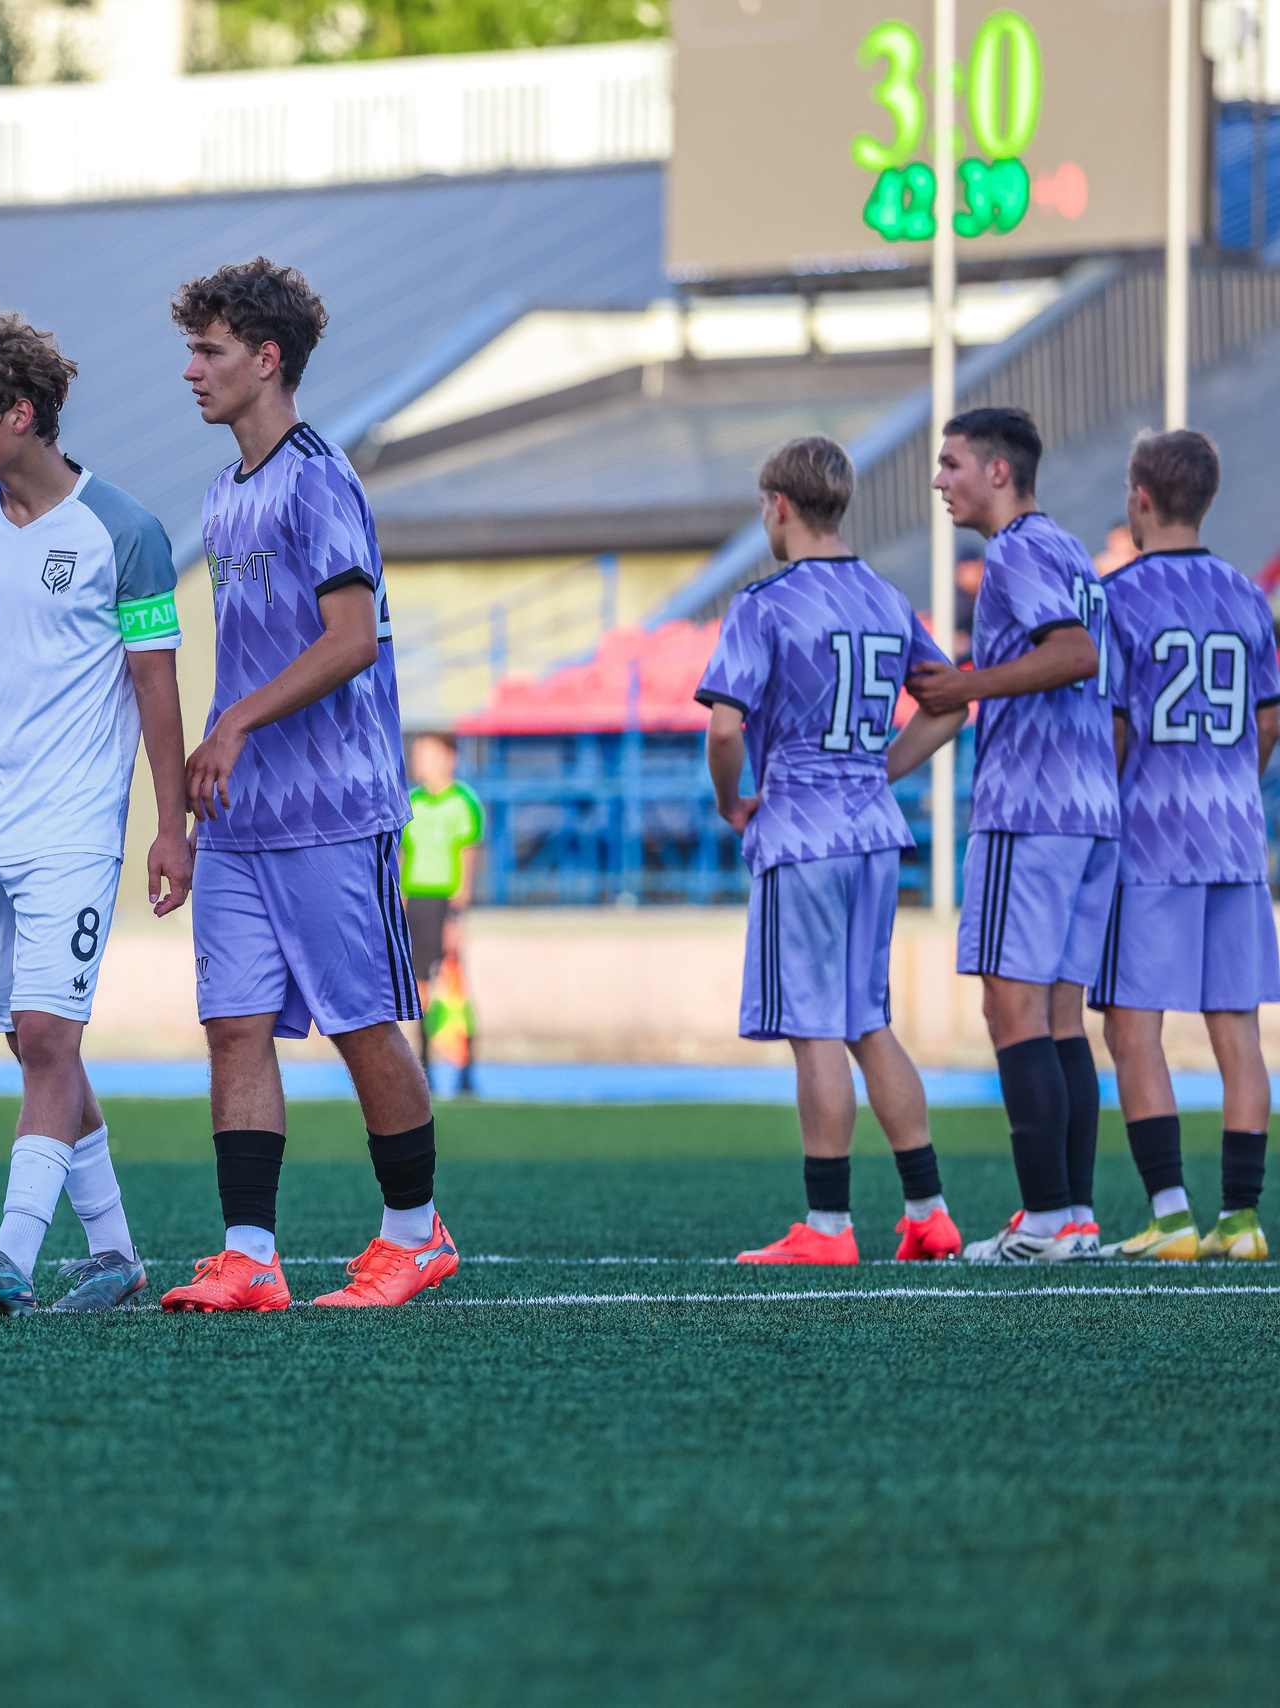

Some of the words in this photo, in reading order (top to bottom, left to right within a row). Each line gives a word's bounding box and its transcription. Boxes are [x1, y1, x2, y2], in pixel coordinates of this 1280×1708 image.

[208, 549, 276, 603] ЕНИТ
[821, 631, 903, 753] 15
[1151, 629, 1248, 747] 29
[71, 906, 100, 962] 8
